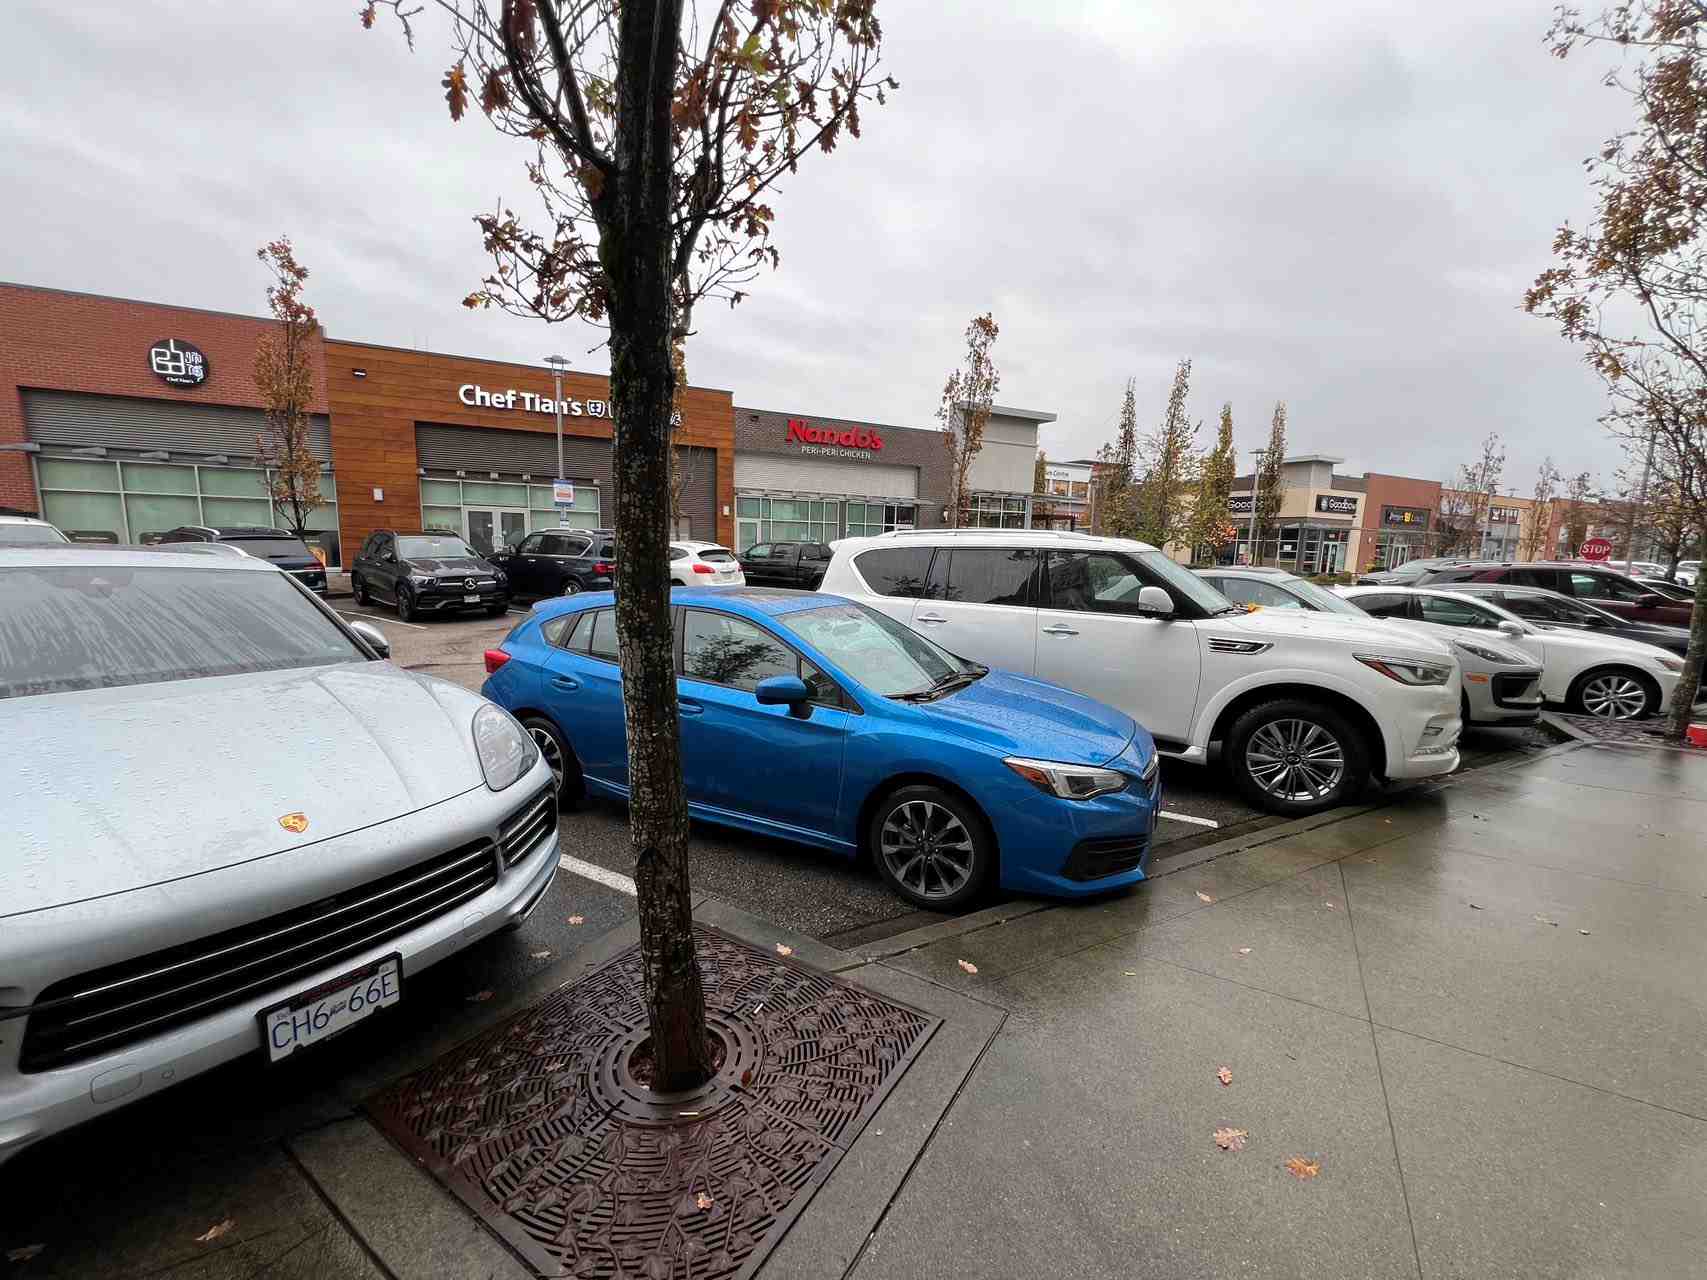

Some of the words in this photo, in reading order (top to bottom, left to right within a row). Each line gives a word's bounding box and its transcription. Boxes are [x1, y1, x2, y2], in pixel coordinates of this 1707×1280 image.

[458, 384, 516, 409] Chef
[519, 392, 583, 416] Tian's
[786, 419, 884, 449] Nando's
[801, 446, 838, 456] PERI-PERI
[839, 449, 871, 460] CHICKEN
[1582, 544, 1610, 556] STOP
[272, 1002, 329, 1048] CH6
[349, 970, 400, 1012] 66E
